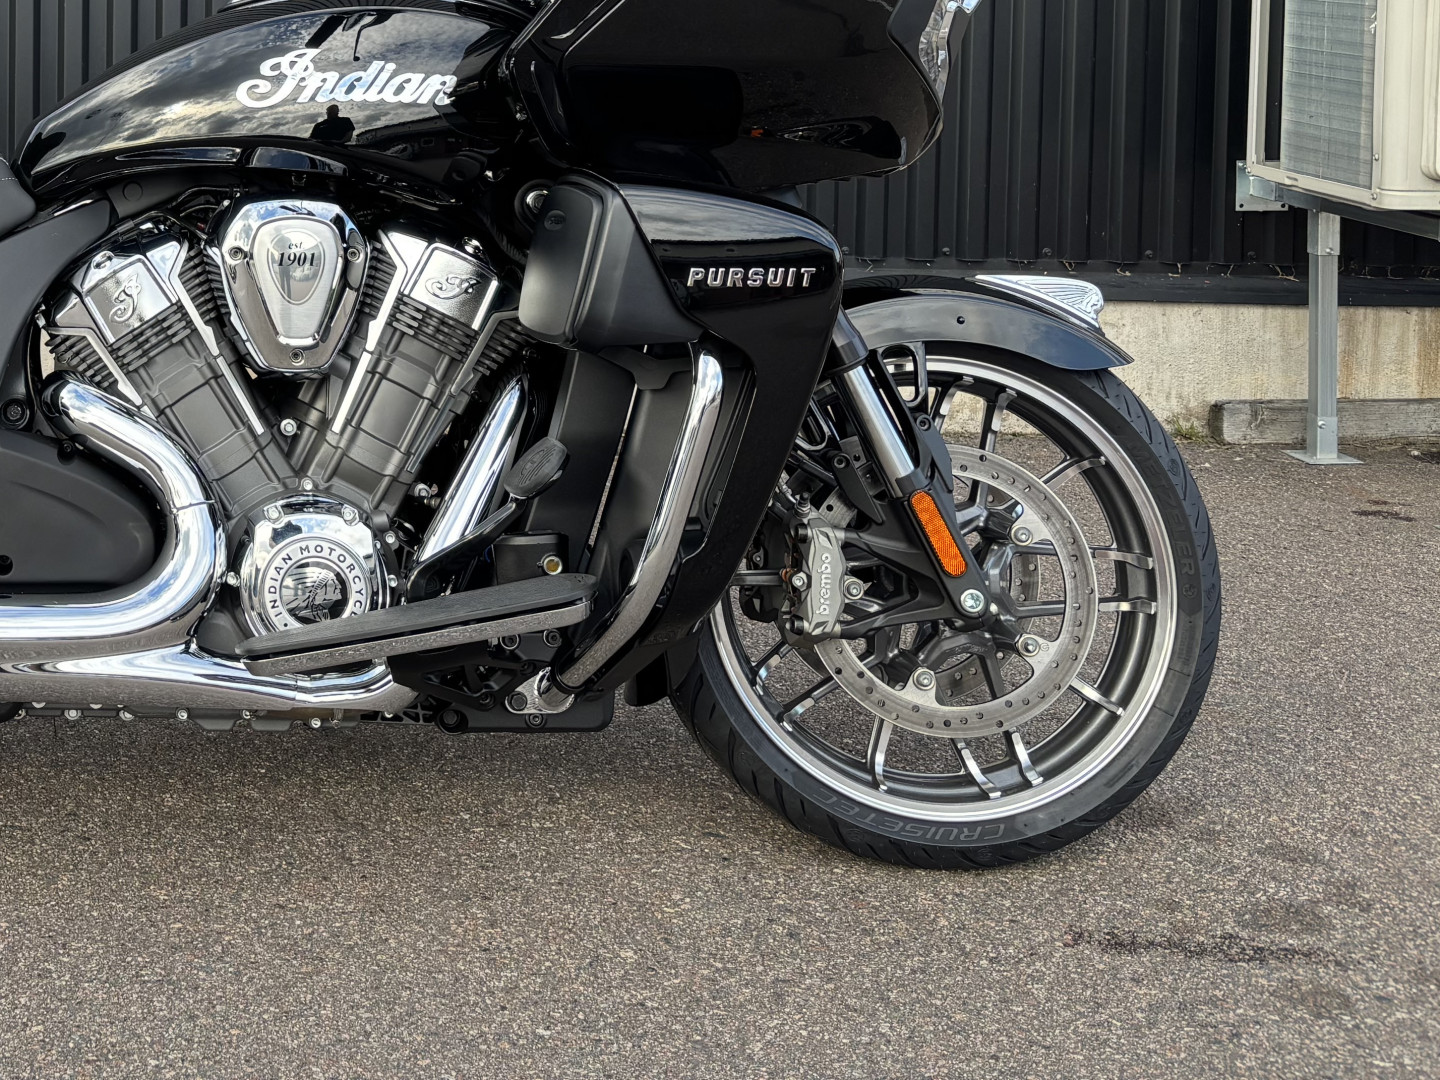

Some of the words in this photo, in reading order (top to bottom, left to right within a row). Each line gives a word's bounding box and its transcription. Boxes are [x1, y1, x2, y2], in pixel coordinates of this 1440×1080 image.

[235, 48, 458, 108] Indian
[277, 251, 316, 267] 1901
[686, 267, 817, 287] PURSUIT
[268, 552, 294, 618] INDIAN
[816, 553, 832, 615] brembo
[812, 788, 1006, 842] CRUISETEC
